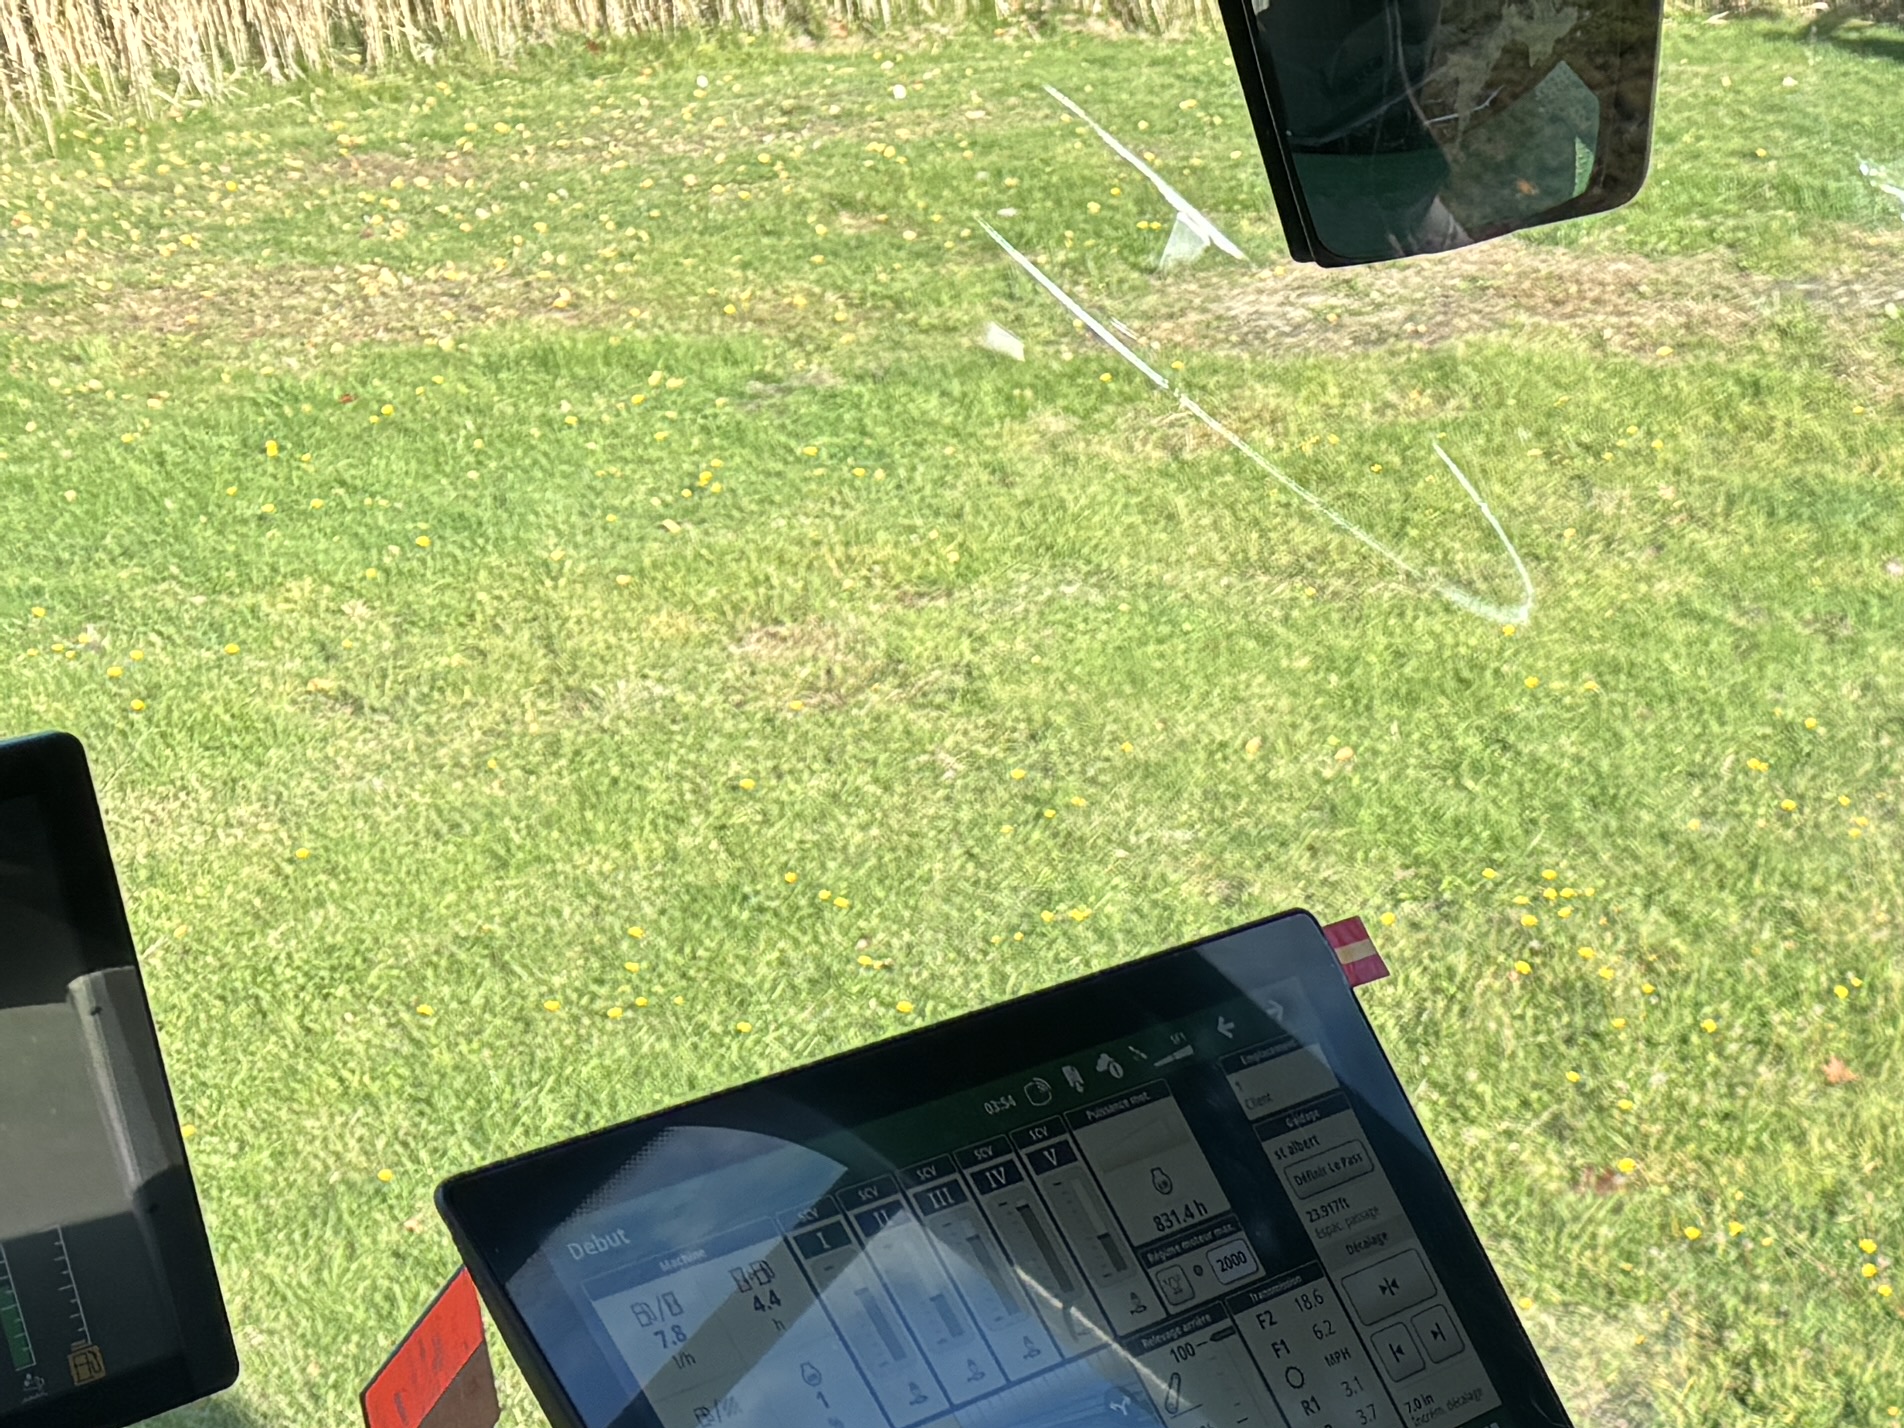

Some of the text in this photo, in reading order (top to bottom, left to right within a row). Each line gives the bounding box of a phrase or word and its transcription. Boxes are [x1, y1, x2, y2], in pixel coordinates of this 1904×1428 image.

[1029, 1126, 1049, 1141] SCV
[1288, 1134, 1321, 1155] albert
[974, 1145, 994, 1161] SCV
[1043, 1148, 1058, 1167] V
[916, 1165, 938, 1181] SCV
[984, 1166, 1008, 1188] IV
[858, 1185, 879, 1201] SCV
[928, 1188, 955, 1210] III
[872, 1209, 889, 1229] II
[1152, 1199, 1209, 1232] 831.4 h
[815, 1232, 831, 1250] I
[659, 1248, 707, 1272] Machine
[1216, 1250, 1248, 1274] 2000
[753, 1288, 782, 1313] 4.4
[1255, 1288, 1325, 1330] F2 18.6
[771, 1318, 787, 1333] h
[653, 1325, 687, 1349] 7.8
[1271, 1319, 1337, 1359] F1 6.2
[1169, 1342, 1196, 1364] 100
[1324, 1346, 1353, 1368] MPH
[1300, 1375, 1365, 1417] R1 3.1
[1403, 1398, 1422, 1414] 7.0
[1355, 1403, 1377, 1426] 3.7
